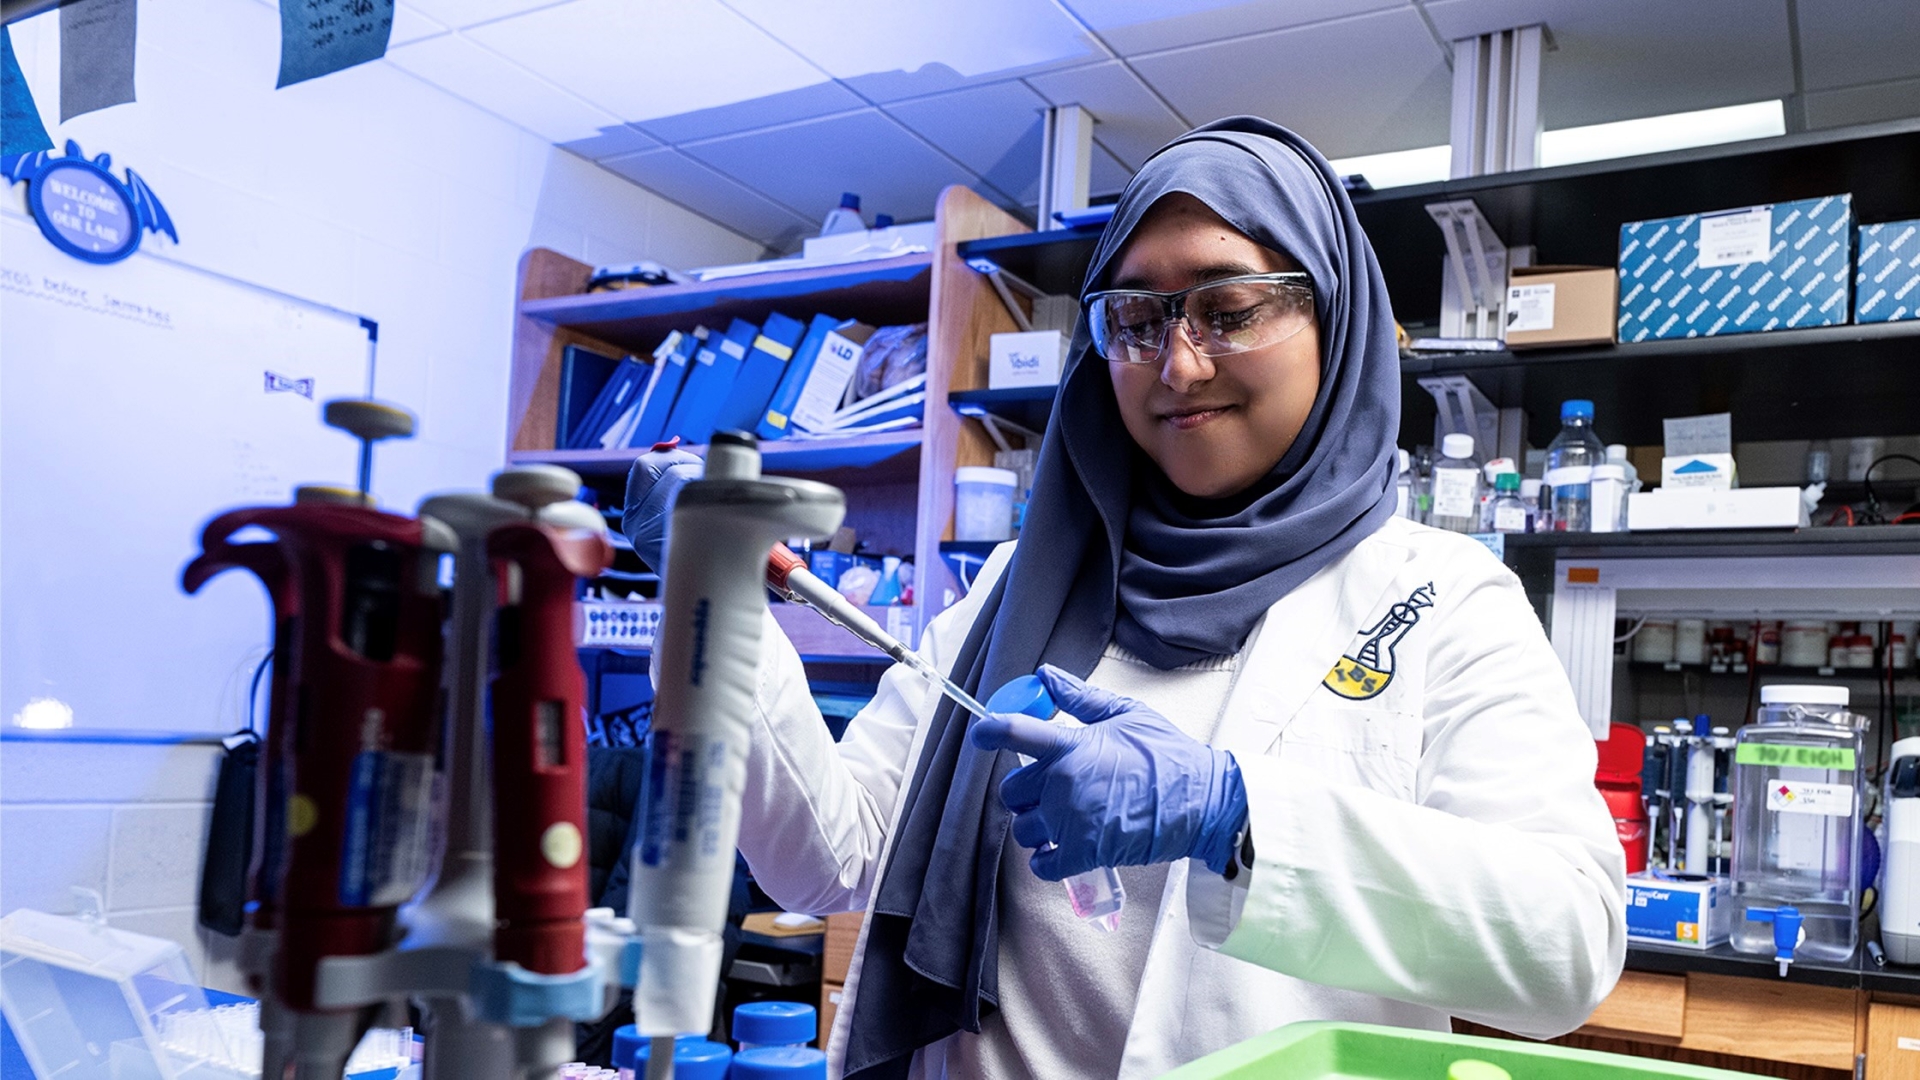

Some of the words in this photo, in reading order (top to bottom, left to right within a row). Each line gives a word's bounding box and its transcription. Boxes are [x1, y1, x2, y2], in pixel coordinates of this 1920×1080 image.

[50, 179, 120, 215] WELCOME
[78, 203, 97, 221] TO
[1682, 924, 1694, 938] S
